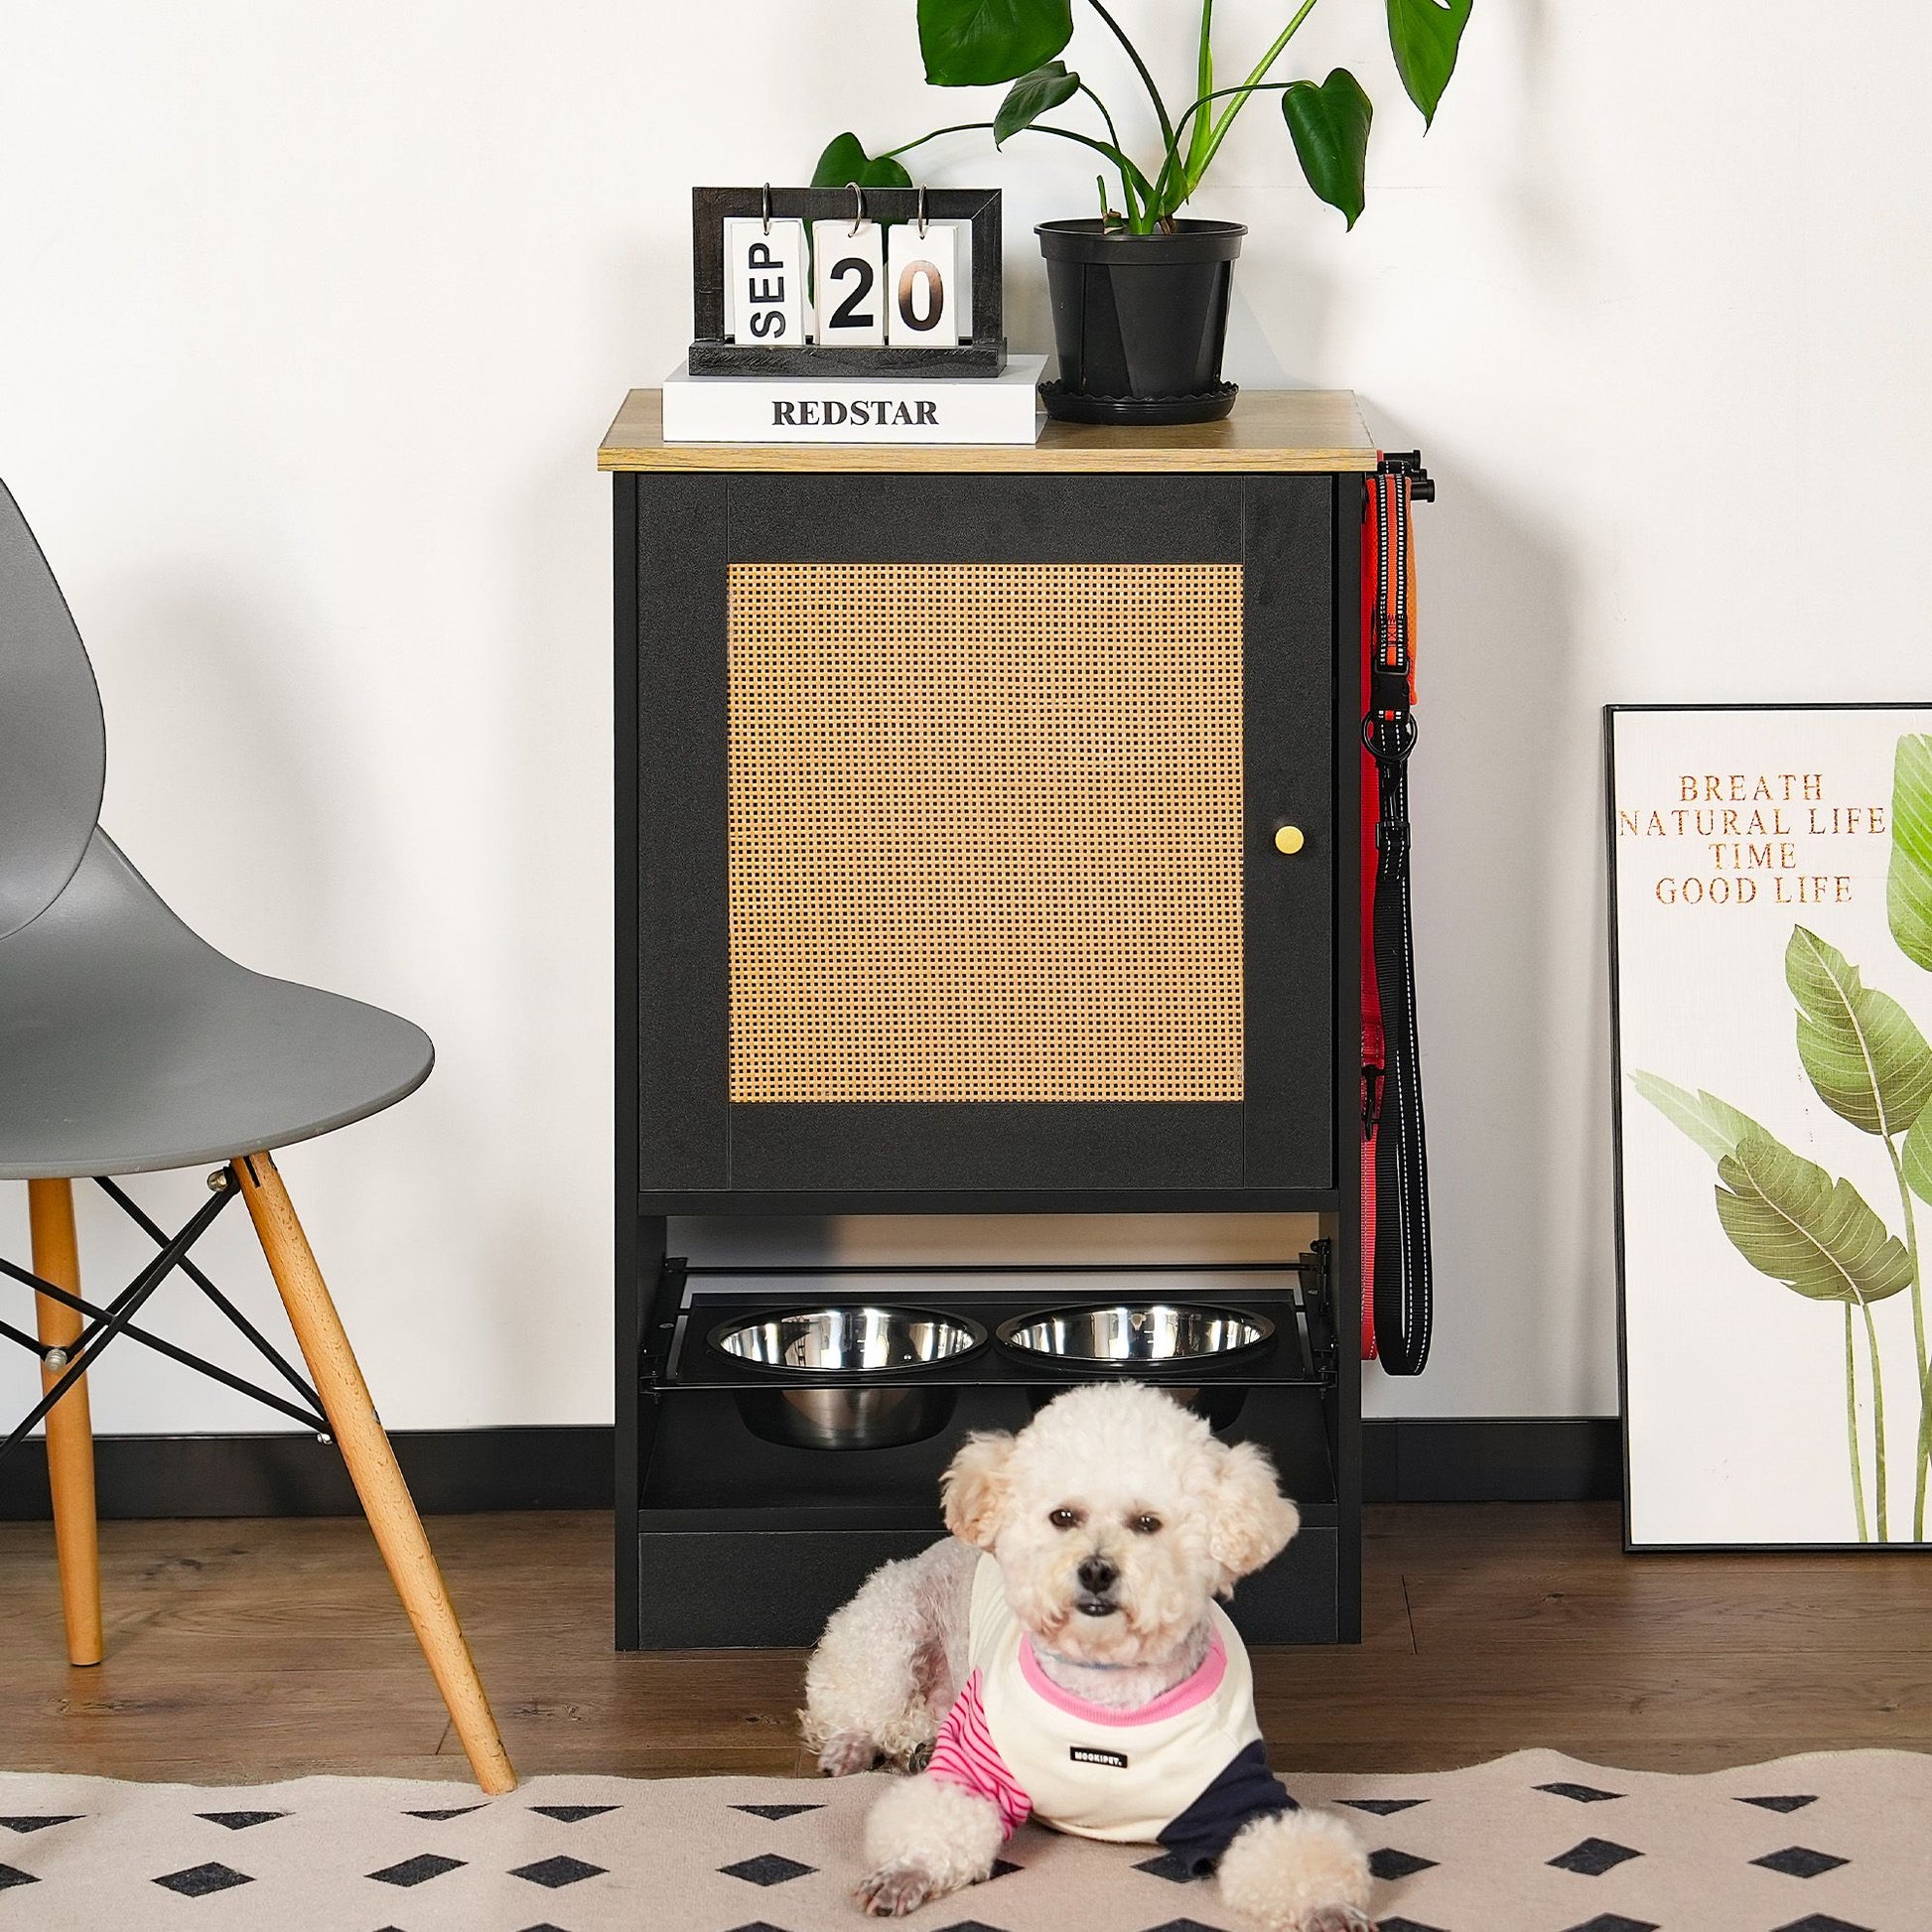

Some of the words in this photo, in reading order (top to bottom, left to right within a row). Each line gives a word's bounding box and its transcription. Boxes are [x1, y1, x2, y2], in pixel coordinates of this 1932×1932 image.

[749, 242, 785, 339] SEP
[771, 400, 939, 426] REDSTAR
[1679, 773, 1824, 802] BREATH
[1618, 808, 1791, 836] NATURAL
[1808, 807, 1886, 835] LIFE
[1709, 843, 1797, 870] TIME
[1655, 877, 1757, 904] GOOD
[1774, 876, 1853, 904] LIFE
